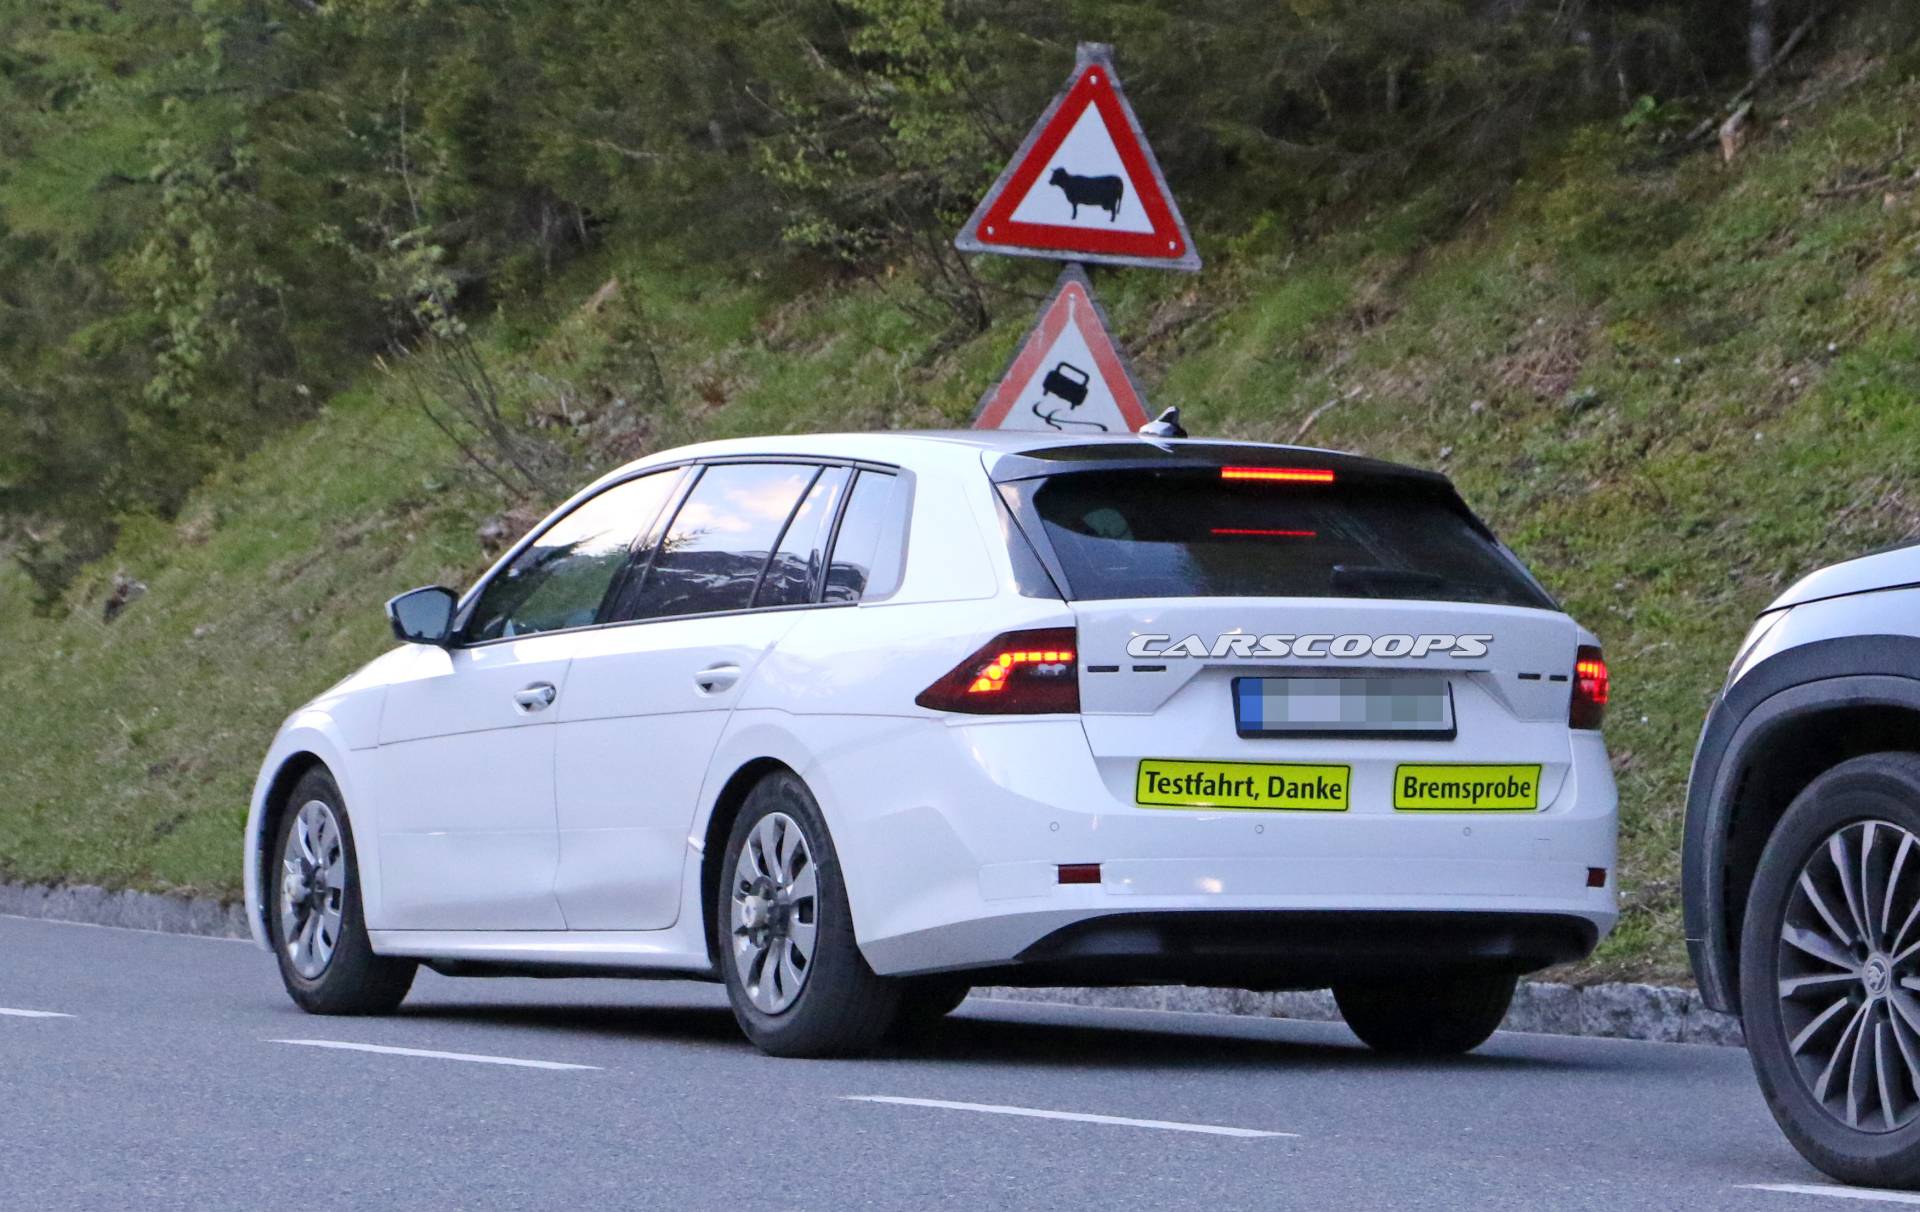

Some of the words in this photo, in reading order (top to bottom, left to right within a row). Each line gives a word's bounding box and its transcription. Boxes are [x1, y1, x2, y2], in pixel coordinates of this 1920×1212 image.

[1145, 770, 1260, 801] Testfahrt,
[1267, 775, 1342, 801] Danke
[1403, 775, 1531, 805] Bremsprobe
